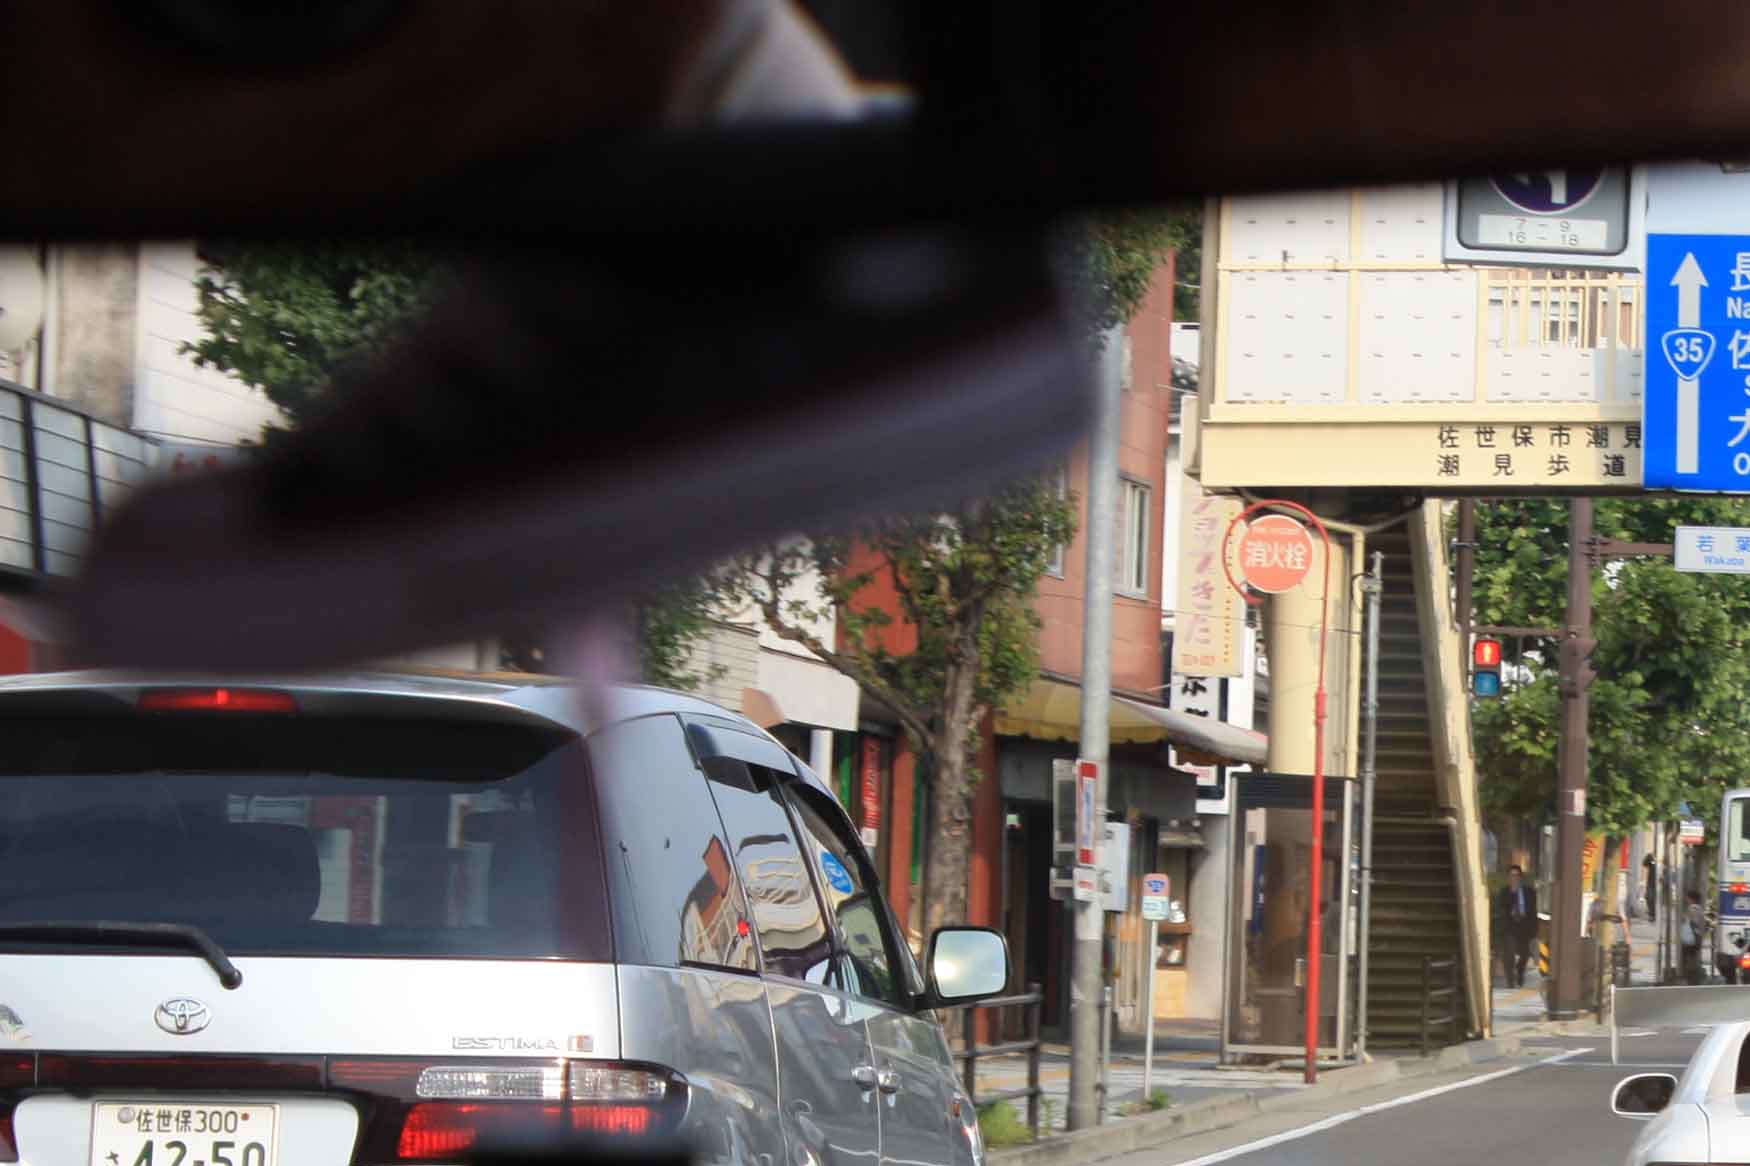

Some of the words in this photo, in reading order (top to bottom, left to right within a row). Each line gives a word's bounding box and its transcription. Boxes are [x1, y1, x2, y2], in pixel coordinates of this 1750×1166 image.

[1507, 231, 1527, 243] 16
[1560, 233, 1579, 246] 18
[1674, 337, 1703, 361] 35
[1246, 541, 1307, 569] 消火栓
[452, 1036, 560, 1050] ESTIMA
